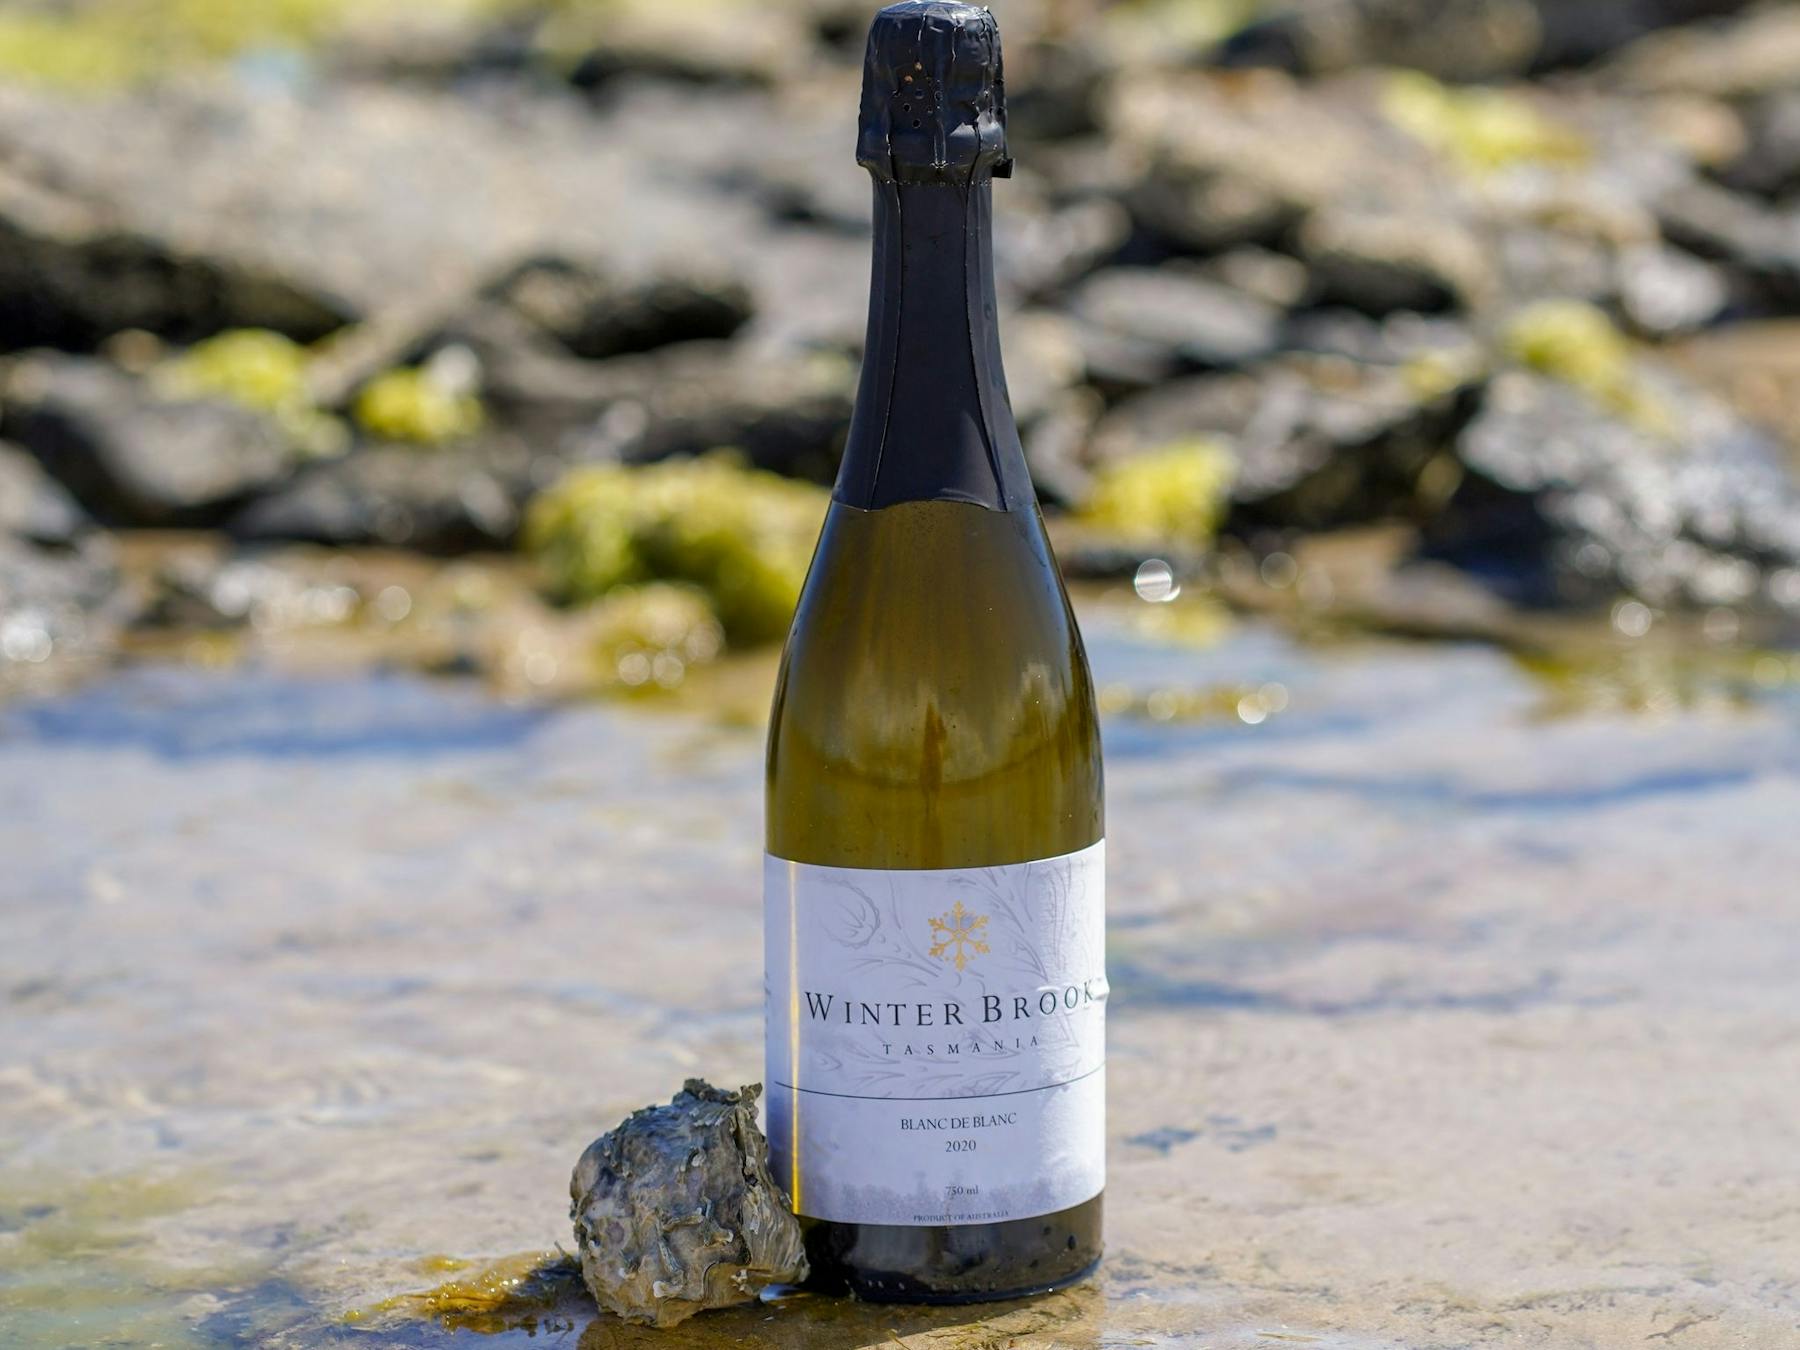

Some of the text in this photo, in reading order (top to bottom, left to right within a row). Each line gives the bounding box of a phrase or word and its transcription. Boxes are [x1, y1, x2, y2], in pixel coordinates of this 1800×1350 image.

[805, 979, 1094, 1026] WINTER BROOK
[883, 1035, 1039, 1056] TASMANIA
[901, 1112, 1017, 1131] BLANC DE BLANC
[945, 1139, 977, 1153] 2020
[946, 1184, 979, 1196] 750 ml
[913, 1210, 1009, 1223] PRODUCT OF AUSTRALIA
